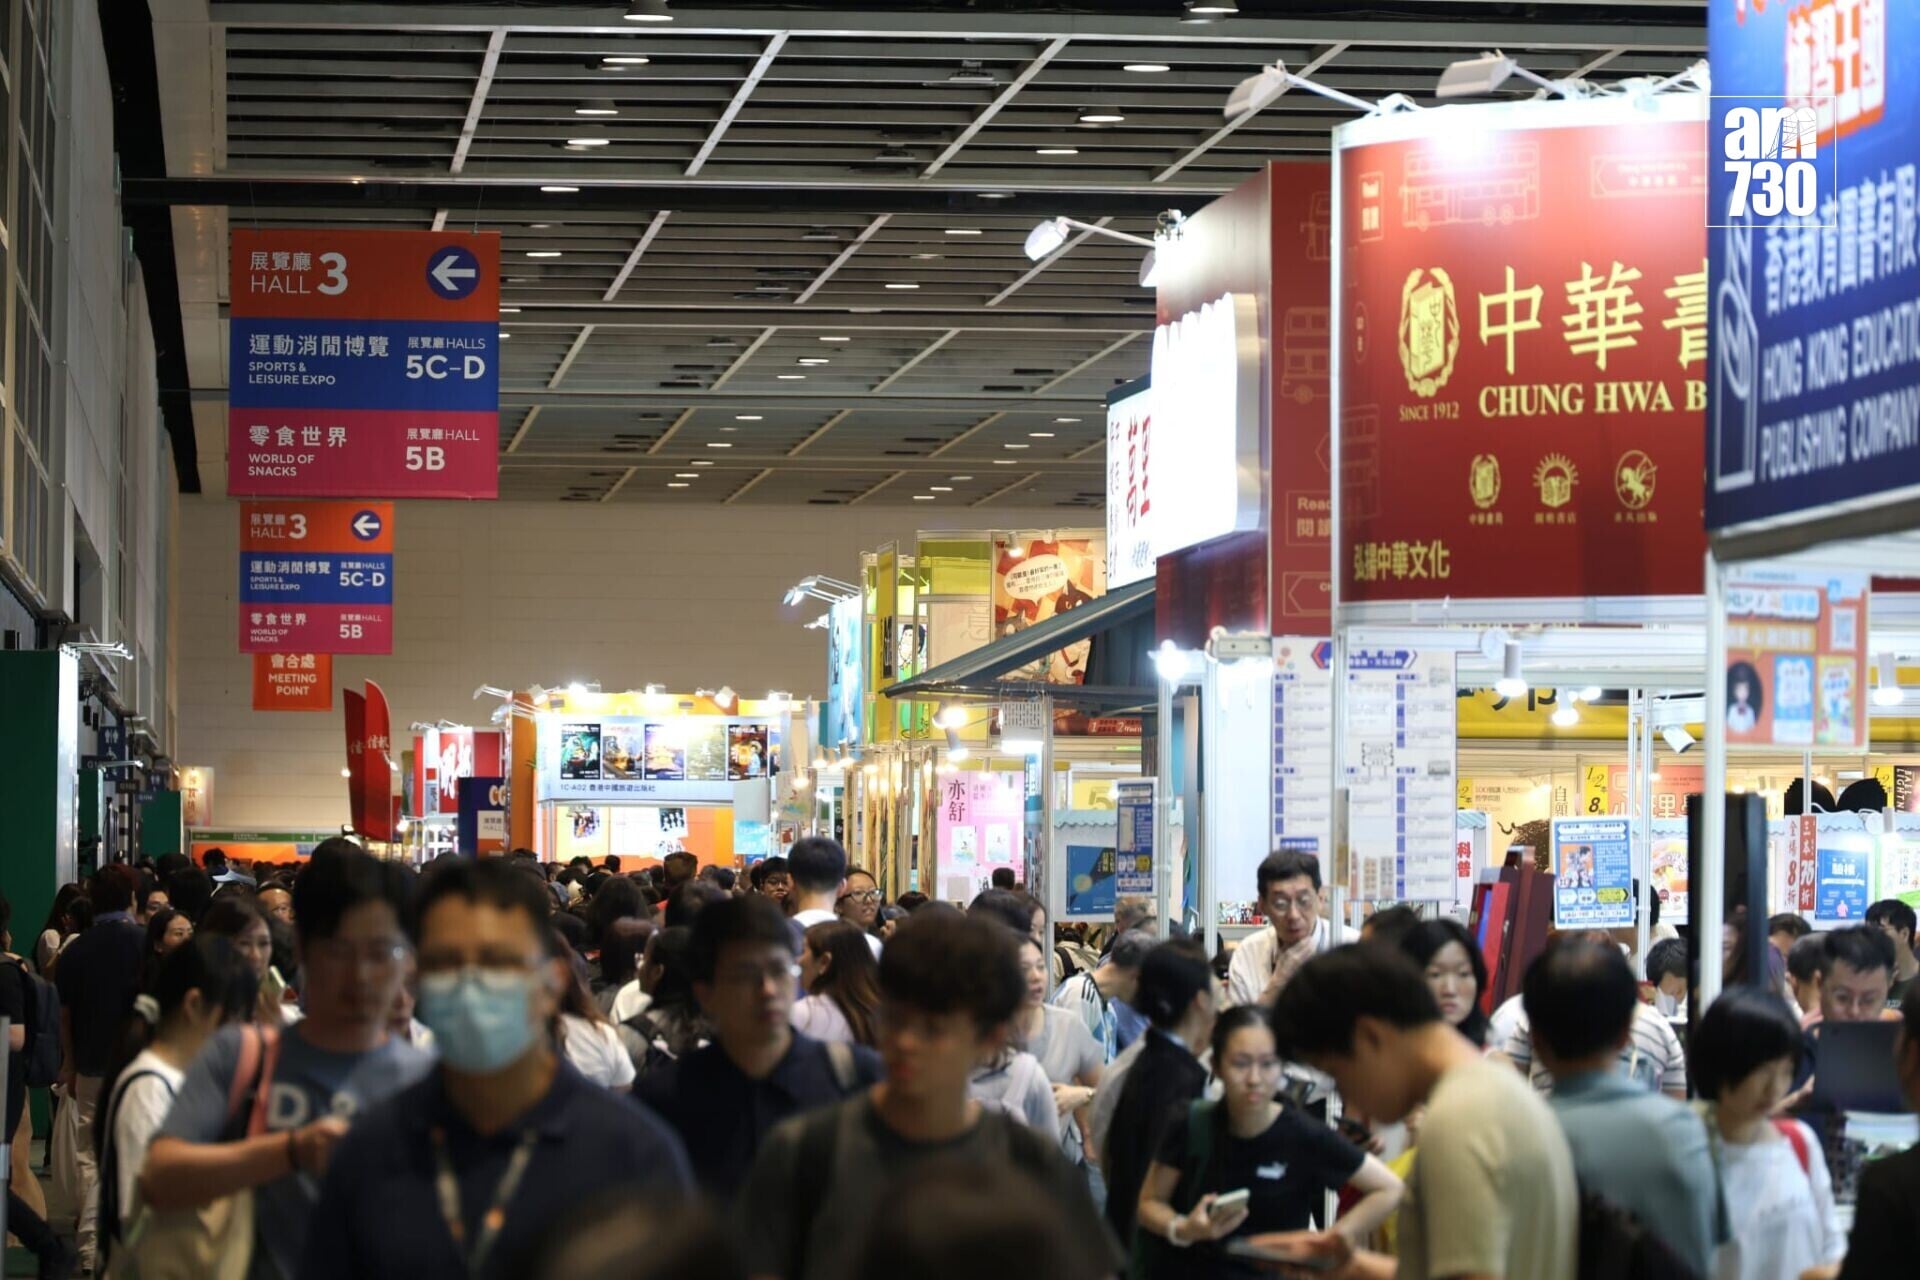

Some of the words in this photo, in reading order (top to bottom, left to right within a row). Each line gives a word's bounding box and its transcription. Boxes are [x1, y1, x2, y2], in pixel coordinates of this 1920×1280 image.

[250, 252, 311, 271] 展覽廳
[250, 275, 311, 294] HALL
[317, 252, 348, 295] 3
[446, 338, 486, 349] HALLS
[249, 361, 296, 372] SPORTS
[298, 361, 306, 372] &
[1762, 335, 1802, 404] HONG
[1807, 322, 1848, 390] KONG
[249, 374, 300, 385] LEISURE
[302, 375, 336, 385] EXPO
[1479, 384, 1585, 417] CHUNG
[1594, 381, 1674, 413] HWA
[1399, 405, 1430, 421] SINCE
[1432, 401, 1460, 420] 1912
[249, 426, 348, 447] 零食世界
[445, 430, 480, 441] HALL
[1760, 405, 1847, 482] PUBLISHING
[249, 454, 295, 464] WORLD
[297, 454, 315, 464] OF
[405, 446, 446, 471] 5B
[248, 466, 297, 476] SNACKS
[251, 527, 286, 539] HALL
[289, 514, 307, 539] 3
[339, 625, 363, 639] 5B
[268, 674, 317, 684] MEETING
[276, 686, 309, 696] POINT
[948, 779, 966, 822] 亦舒
